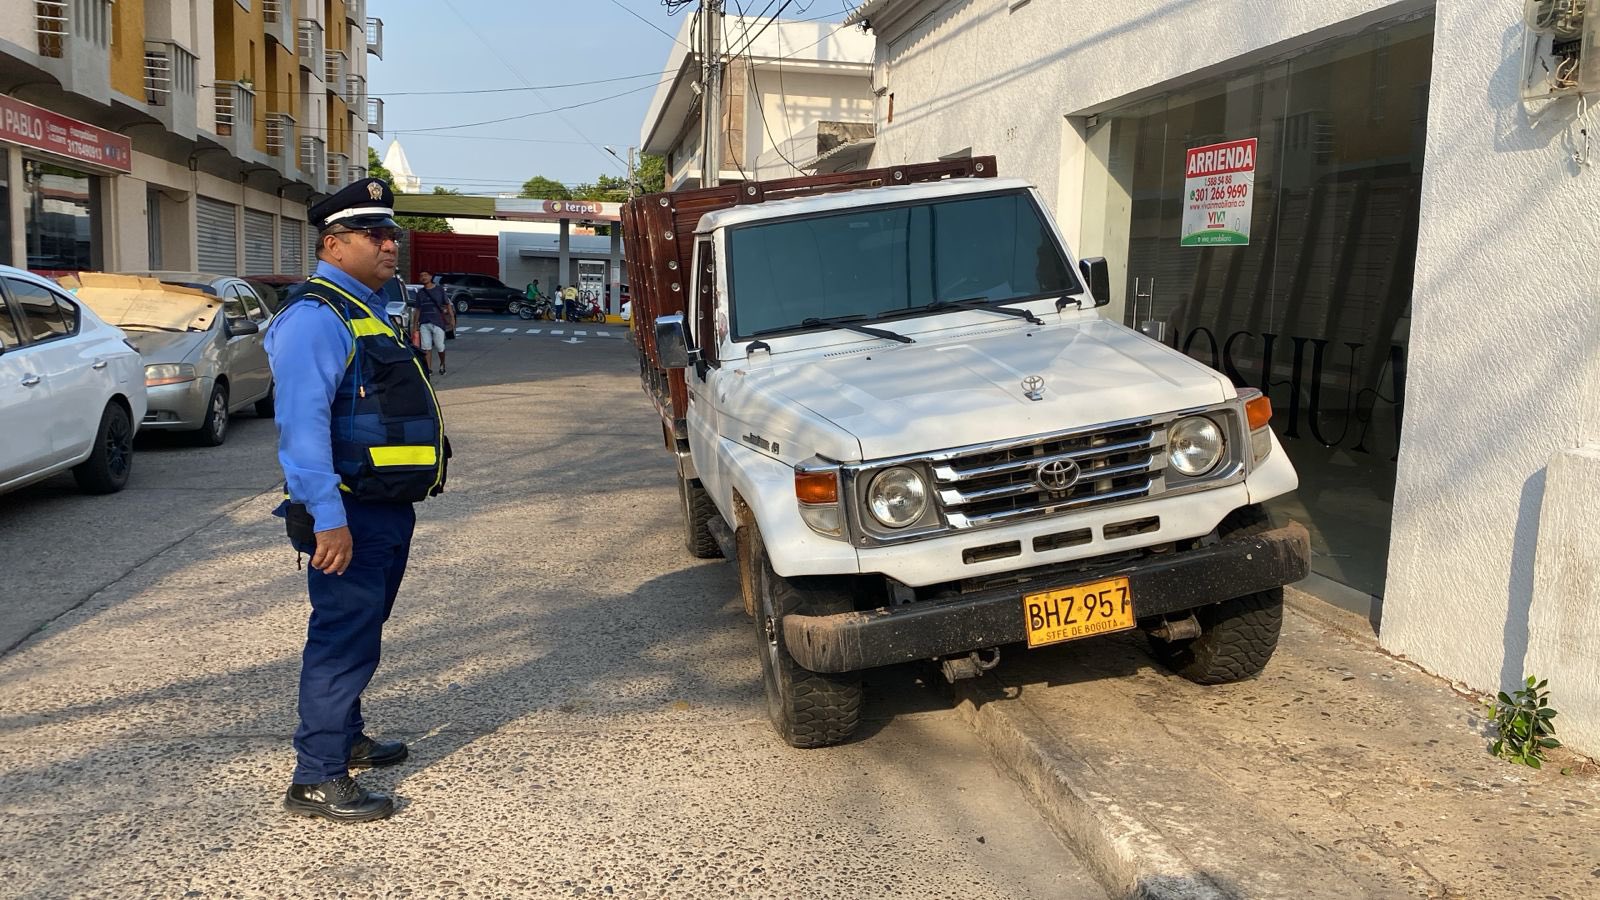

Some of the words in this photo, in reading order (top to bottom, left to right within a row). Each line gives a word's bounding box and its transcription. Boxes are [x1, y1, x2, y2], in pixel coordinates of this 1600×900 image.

[5, 109, 42, 140] PABLO
[1187, 145, 1253, 175] ARRIENDA
[1217, 176, 1224, 185] 54
[1195, 188, 1208, 201] 301
[1211, 186, 1225, 200] 266
[1227, 184, 1248, 198] 9690
[565, 202, 597, 214] terpel
[1208, 211, 1226, 224] VIVA
[1174, 327, 1405, 462] SHUA
[1028, 596, 1077, 632] BHZ
[1083, 586, 1128, 622] 957
[1046, 628, 1068, 641] STFE
[1071, 625, 1083, 636] DE
[1084, 619, 1118, 634] BOGOTA
